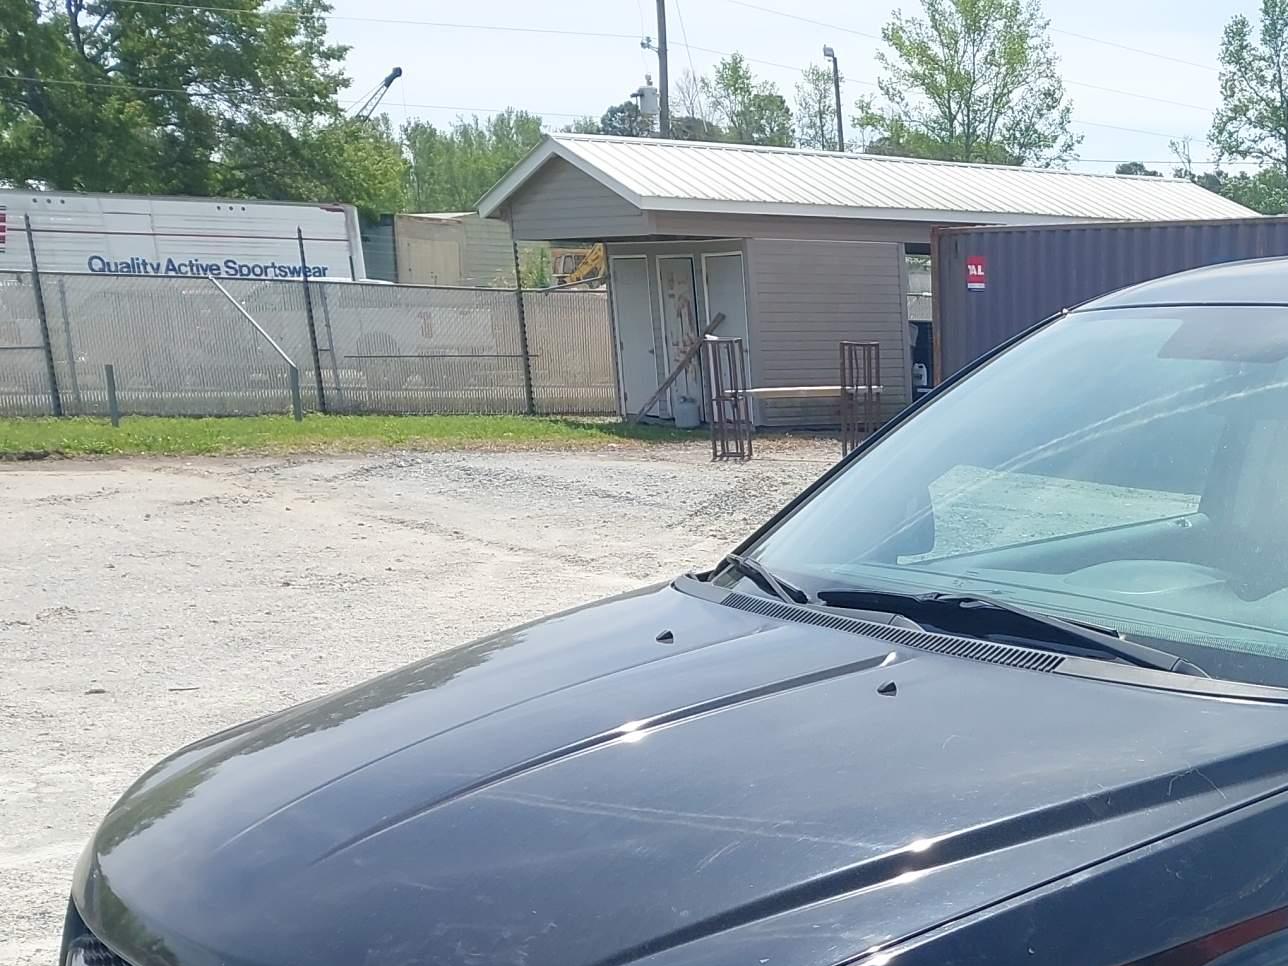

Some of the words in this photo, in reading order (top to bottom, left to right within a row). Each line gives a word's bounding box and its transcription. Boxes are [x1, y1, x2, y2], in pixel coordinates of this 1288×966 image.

[88, 255, 160, 273] Quality
[164, 257, 221, 275] Active
[223, 258, 328, 278] Sportswear
